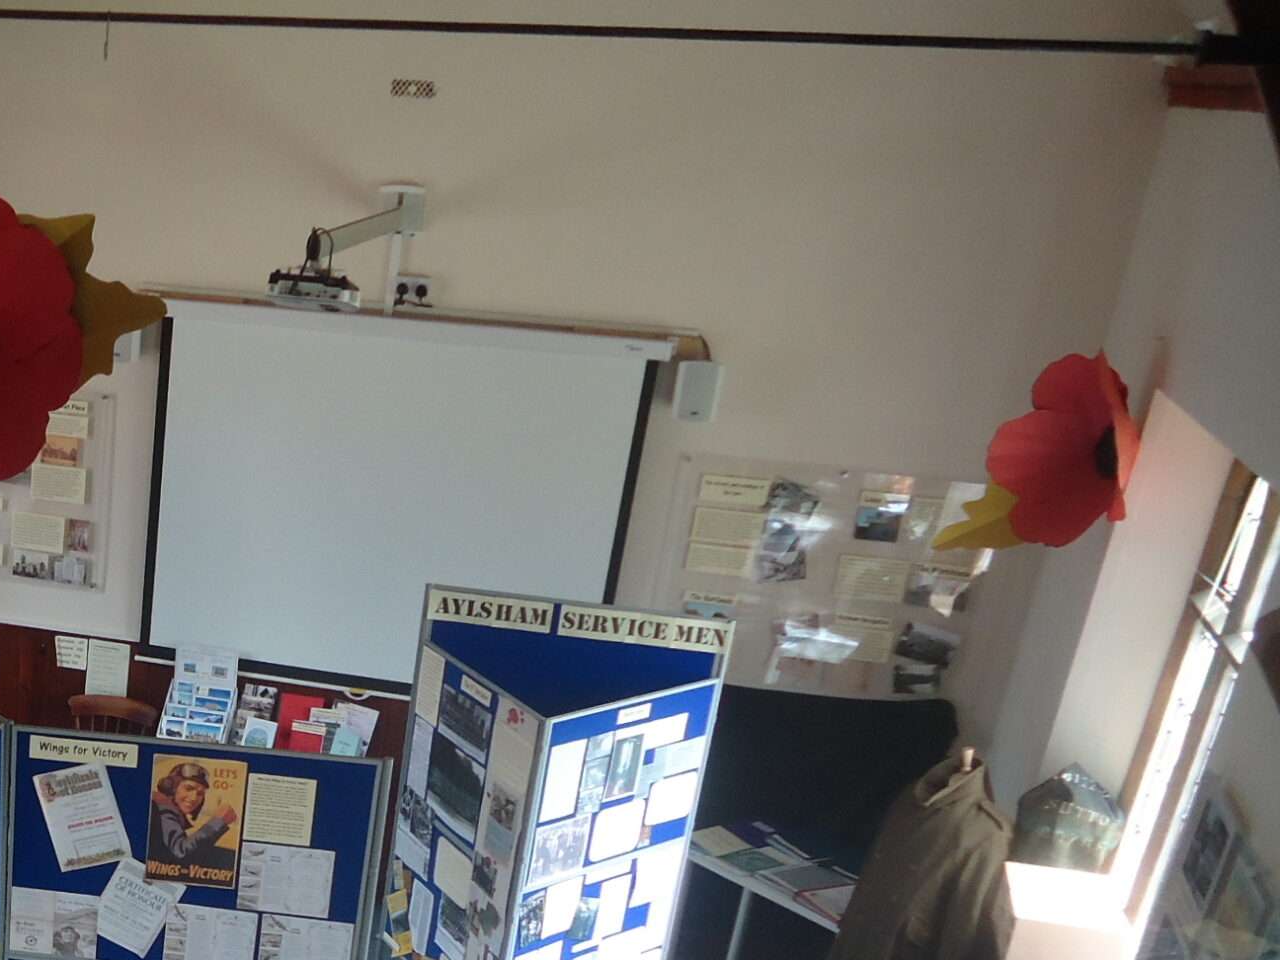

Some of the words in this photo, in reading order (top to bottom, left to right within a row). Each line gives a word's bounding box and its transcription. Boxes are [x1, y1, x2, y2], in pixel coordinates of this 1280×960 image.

[435, 597, 549, 626] AYLSHAM
[562, 611, 669, 641] SERVICE
[673, 624, 728, 647] MEN
[40, 742, 70, 755] Wings
[73, 746, 89, 757] for
[92, 747, 129, 761] Victory
[147, 861, 180, 876] WINGS
[189, 865, 234, 881] VICTORY
